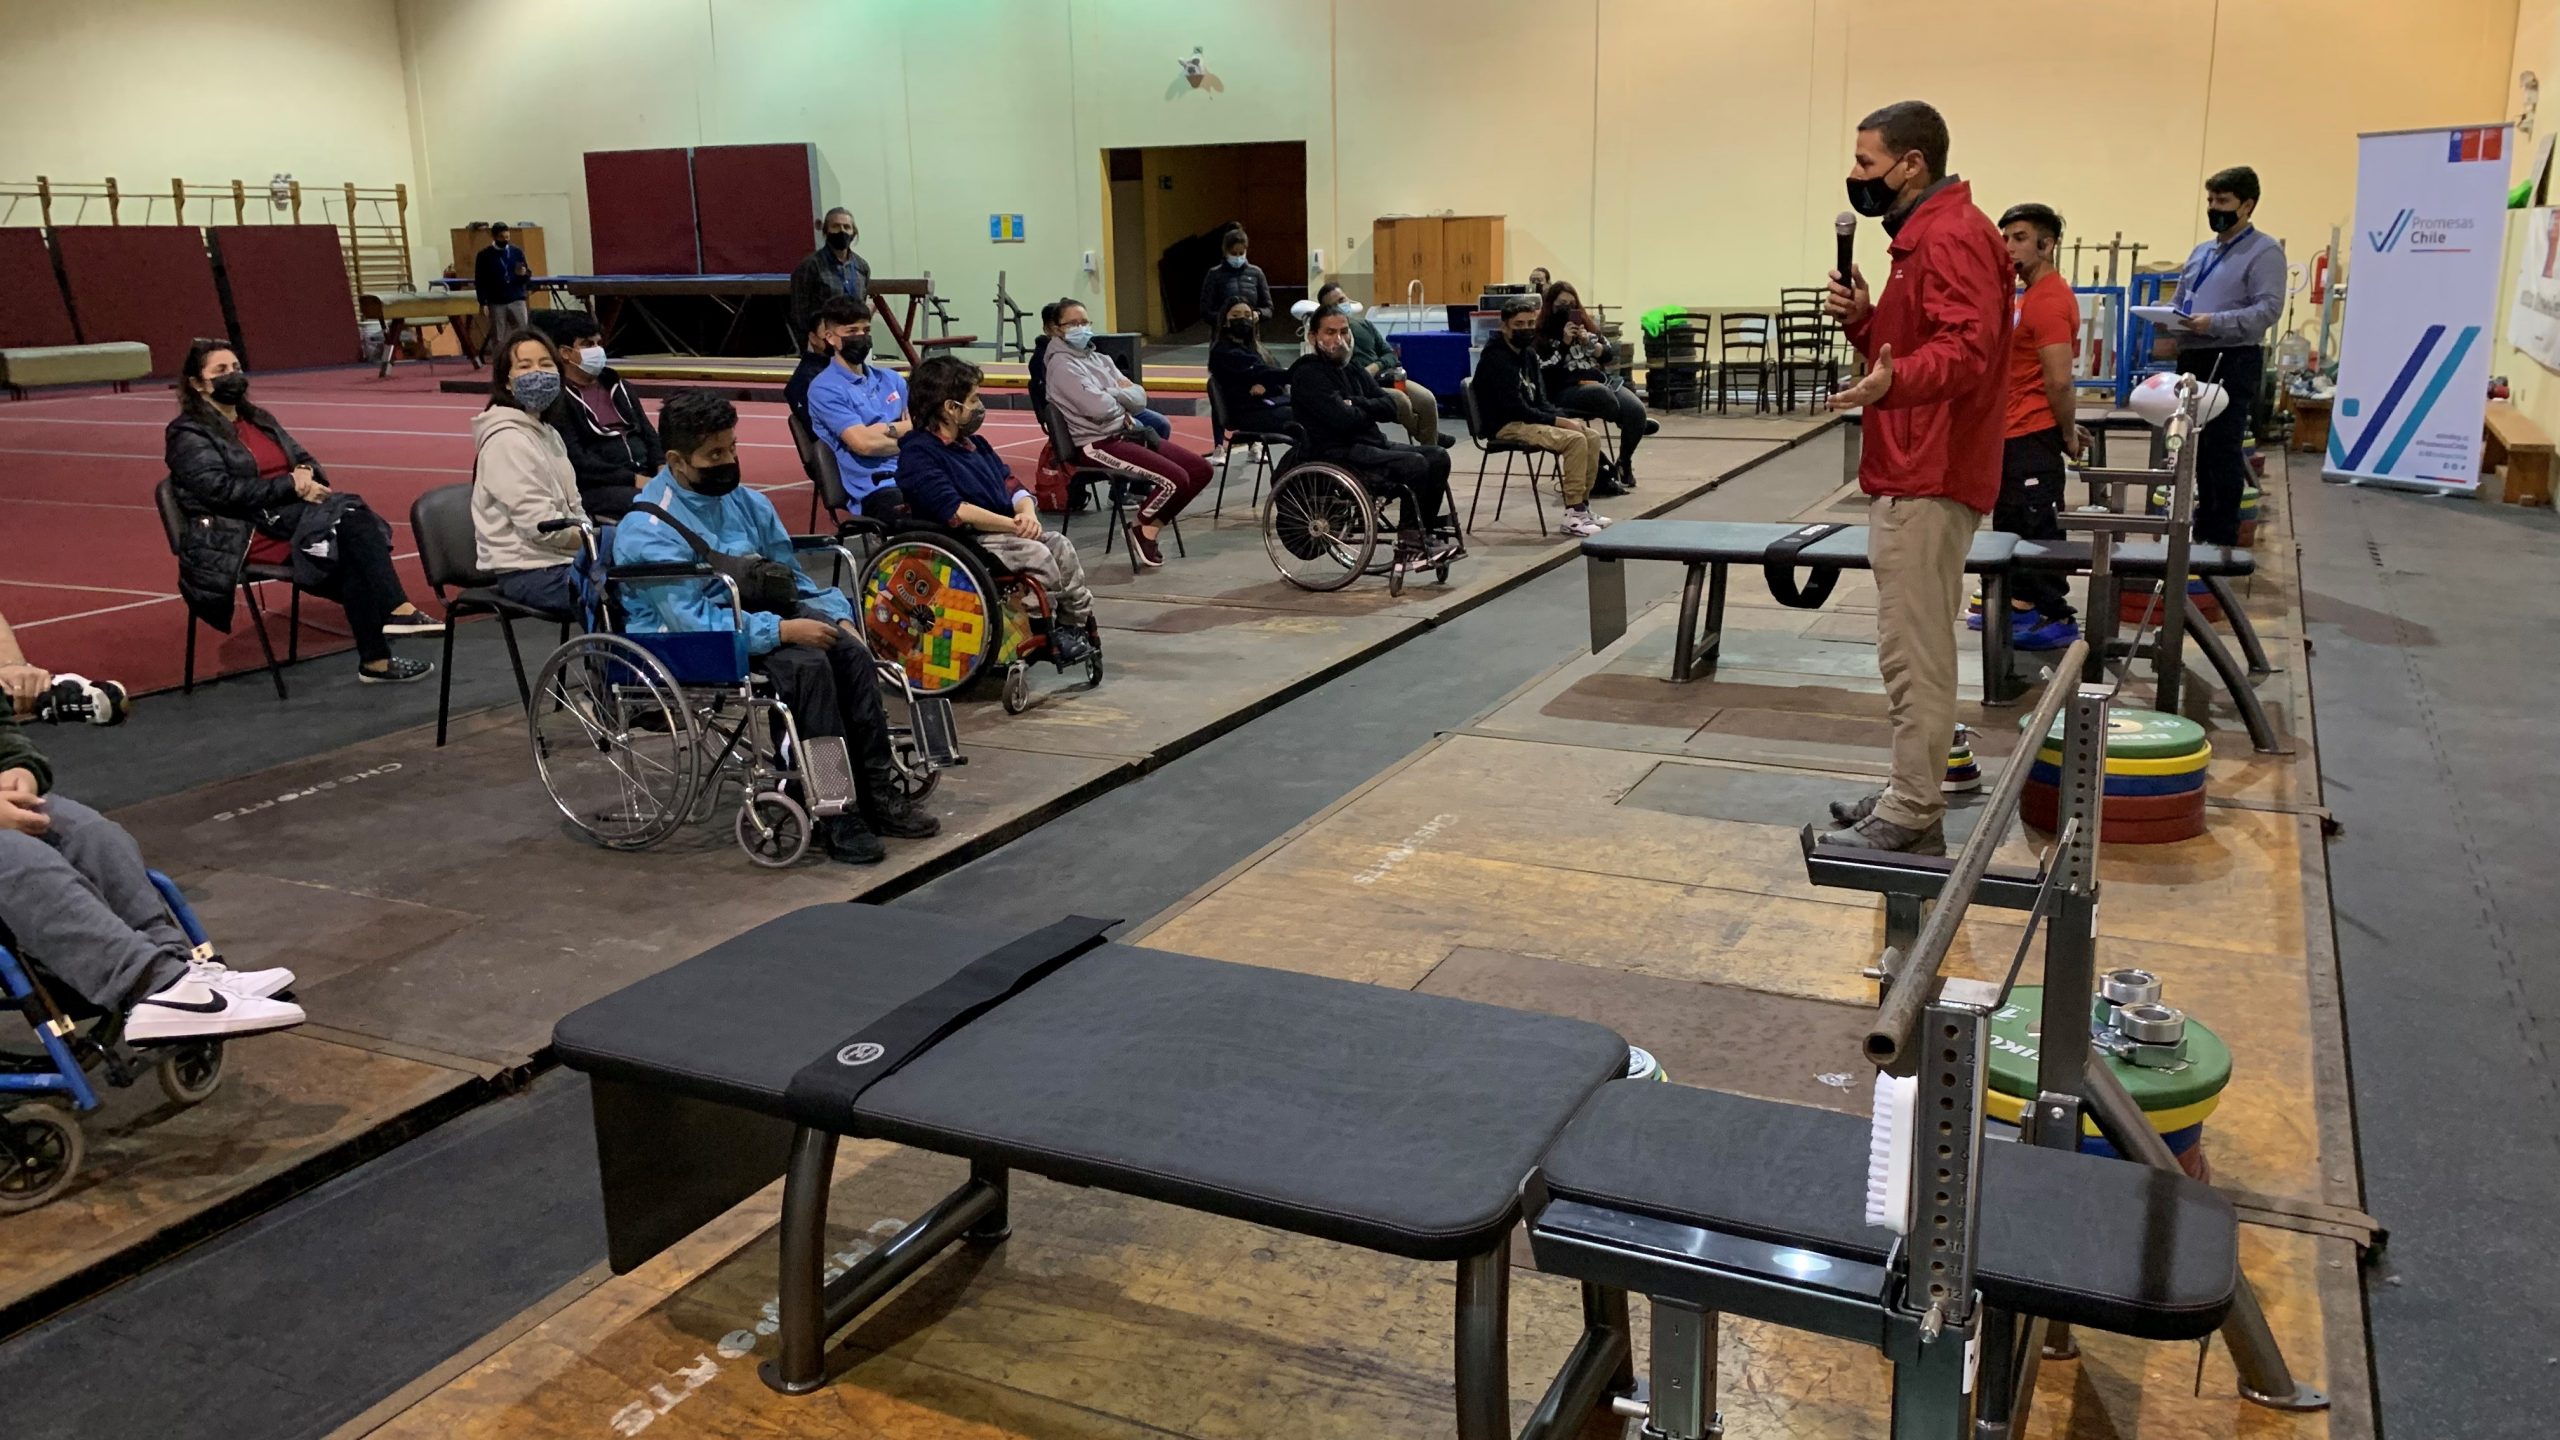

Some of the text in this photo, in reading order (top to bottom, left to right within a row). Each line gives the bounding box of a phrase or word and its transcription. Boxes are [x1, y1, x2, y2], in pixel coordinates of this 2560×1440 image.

[2411, 215, 2474, 230] Promesas
[2410, 230, 2447, 245] Chile
[1965, 1053, 1975, 1064] 2
[1946, 1288, 1962, 1300] 12
